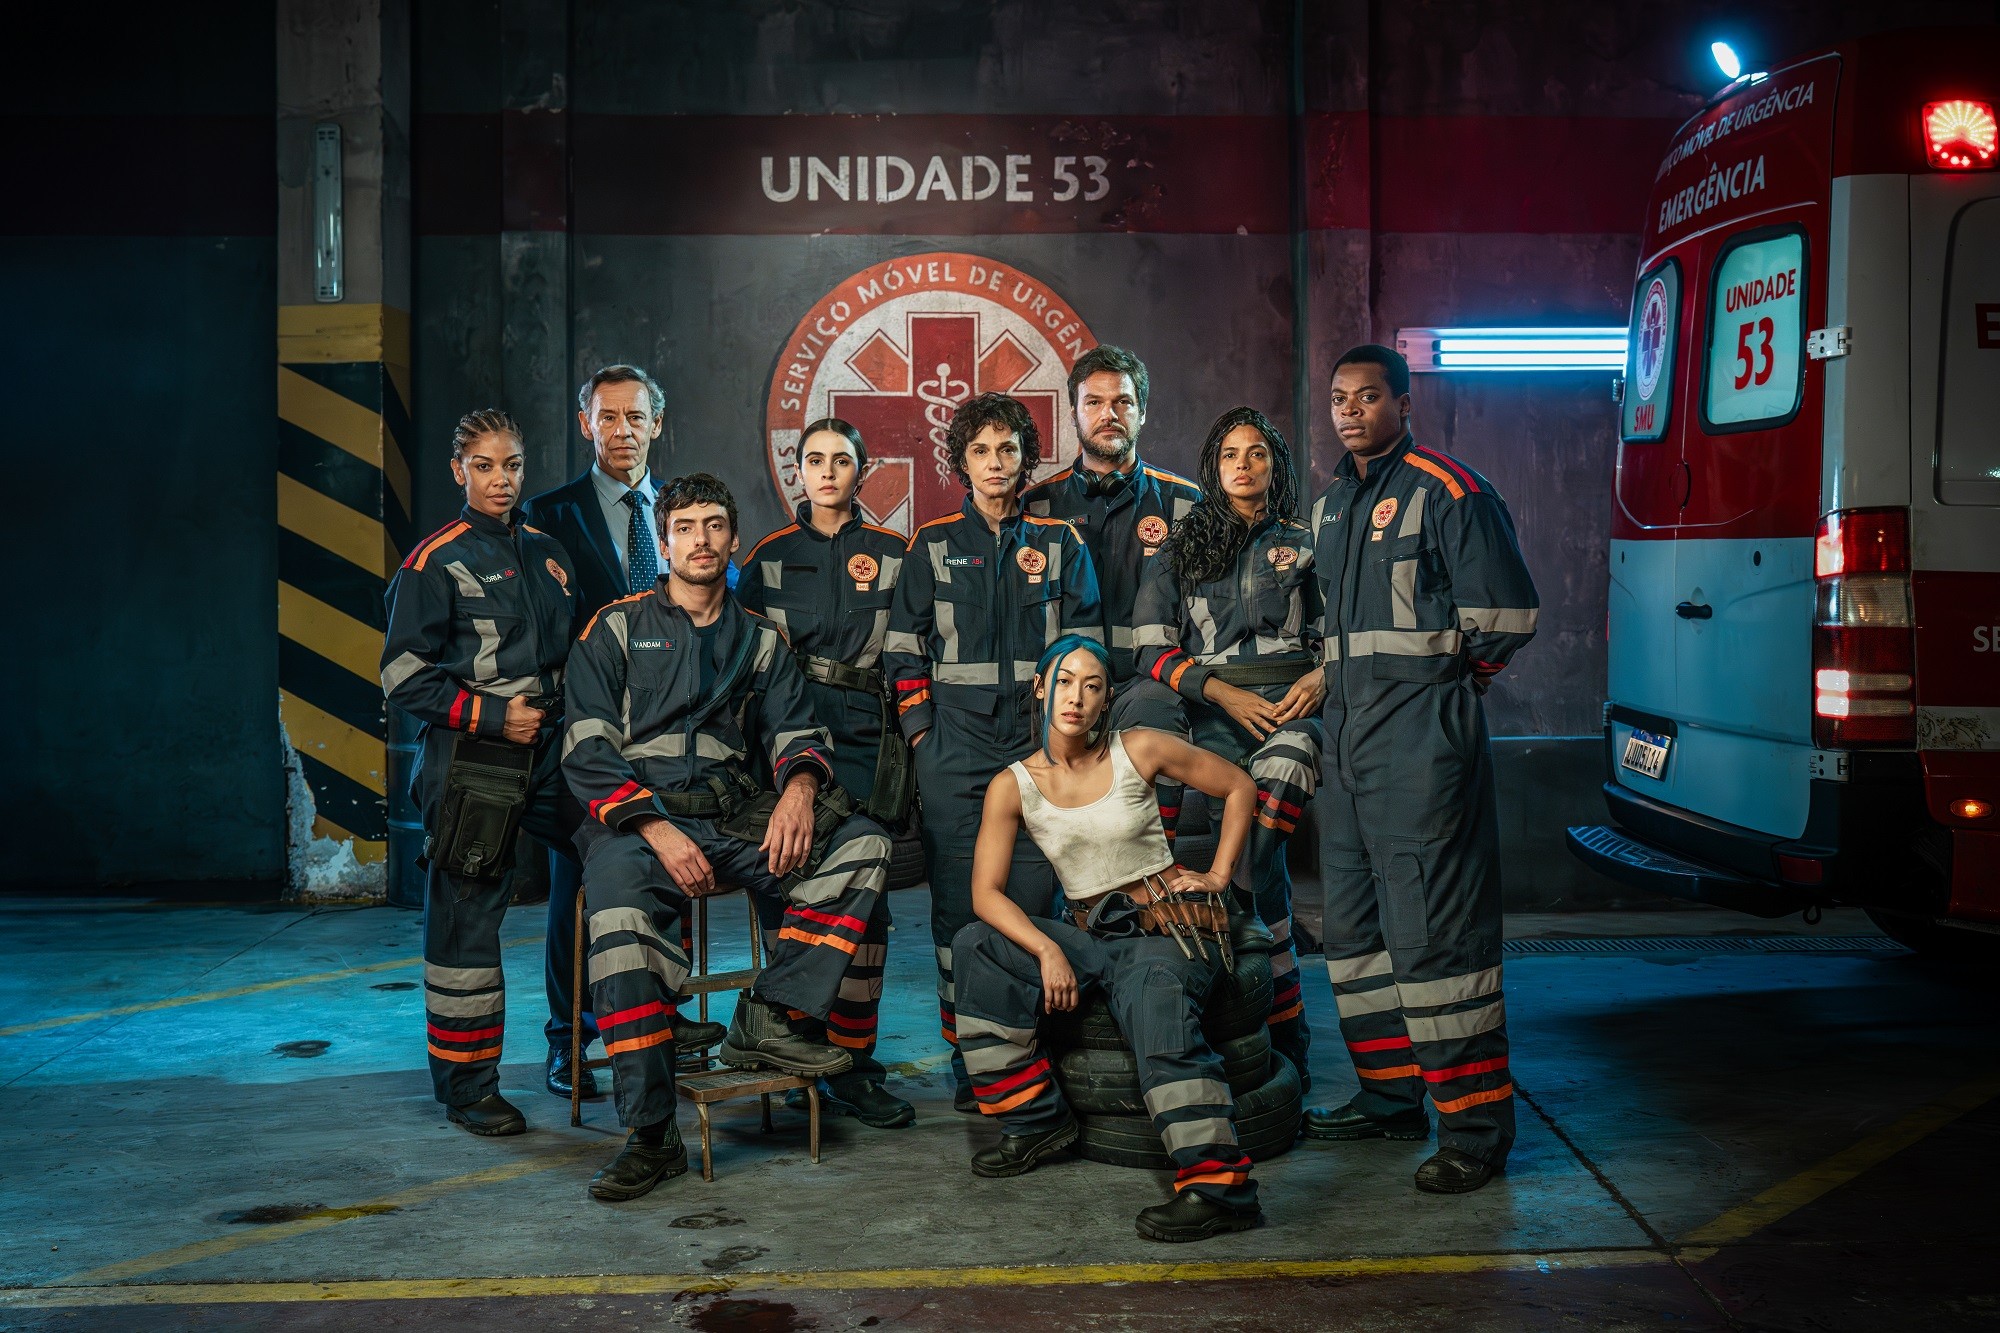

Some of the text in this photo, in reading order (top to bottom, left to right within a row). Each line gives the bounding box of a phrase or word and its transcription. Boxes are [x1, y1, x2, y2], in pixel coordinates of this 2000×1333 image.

[1680, 121, 1716, 161] MÓVEL
[1716, 111, 1736, 140] DE
[1734, 81, 1814, 131] URGÊNCIA
[761, 155, 1110, 203] UNIDADE 53
[1658, 154, 1765, 234] EMERGÊNCIA
[1726, 268, 1797, 313] UNIDADE
[781, 301, 851, 411] SERVIÇO
[856, 262, 957, 304] MÓVEL
[969, 265, 1004, 292] DE
[1734, 317, 1774, 390] 53
[1633, 404, 1655, 432] SMU
[633, 641, 661, 649] VANDAM
